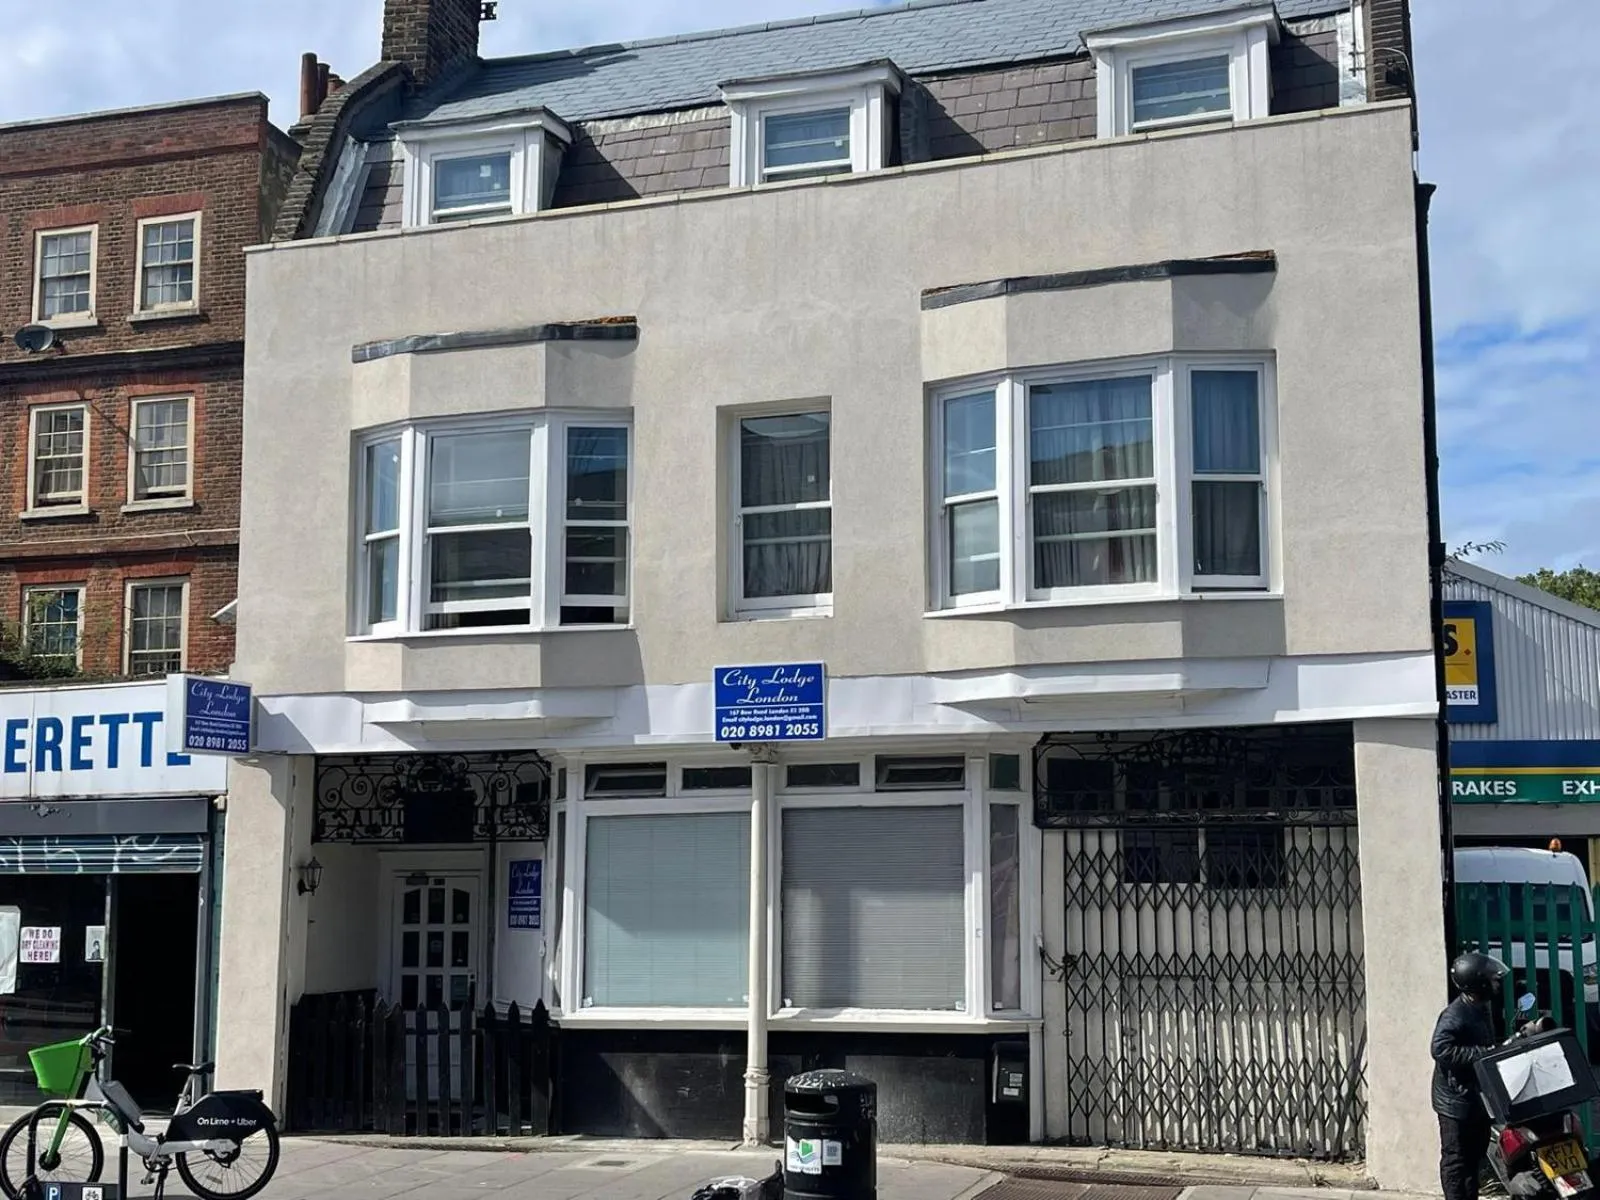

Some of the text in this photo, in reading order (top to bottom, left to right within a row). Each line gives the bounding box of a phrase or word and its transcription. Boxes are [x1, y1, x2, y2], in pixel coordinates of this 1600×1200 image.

[722, 667, 814, 689] City Lodge
[191, 681, 246, 705] City Lodge
[736, 687, 799, 704] London
[199, 701, 237, 717] London
[768, 707, 789, 715] London
[721, 723, 819, 738] 020 8981 2055
[4, 711, 191, 773] ERETT
[189, 735, 247, 751] 020 8981 2055
[1452, 780, 1517, 796] RAKES
[28, 929, 53, 939] WE DO
[28, 951, 52, 961] HERE!
[197, 1117, 257, 1126] On Lime Uber
